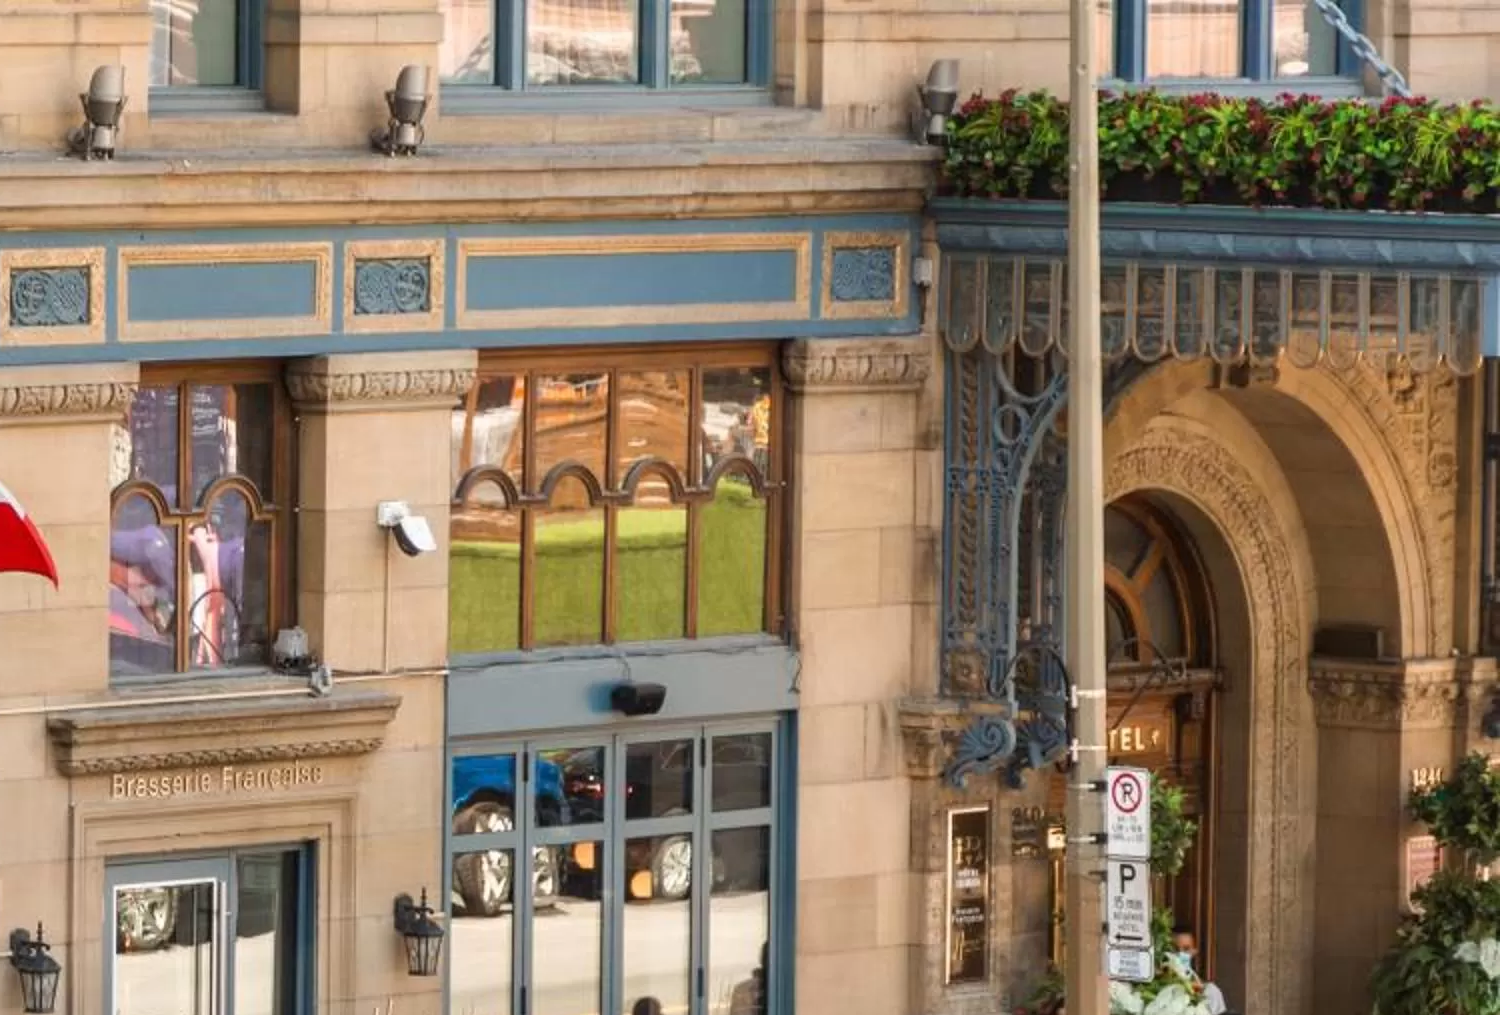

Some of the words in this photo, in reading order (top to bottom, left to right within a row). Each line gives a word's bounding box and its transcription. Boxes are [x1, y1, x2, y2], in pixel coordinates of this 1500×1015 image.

[112, 770, 212, 800] Brasserie
[222, 761, 323, 790] Française
[1118, 863, 1137, 894] P
